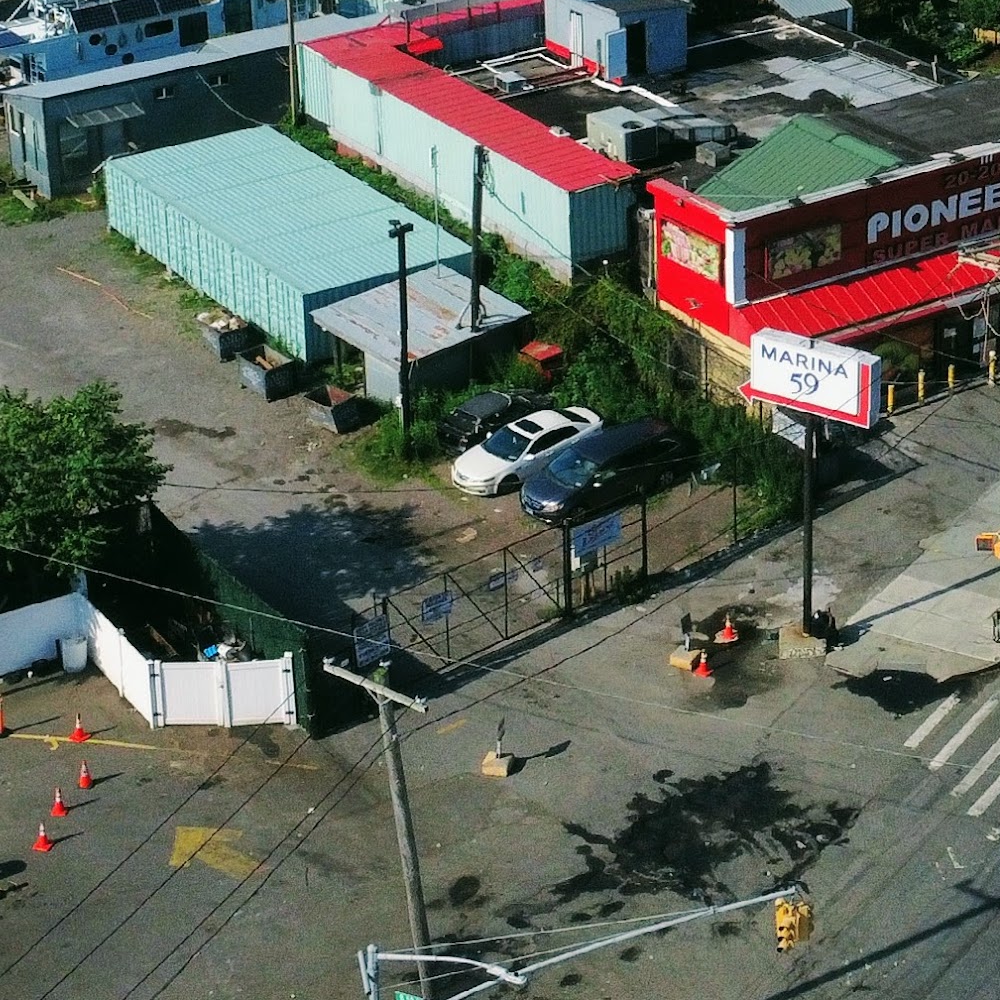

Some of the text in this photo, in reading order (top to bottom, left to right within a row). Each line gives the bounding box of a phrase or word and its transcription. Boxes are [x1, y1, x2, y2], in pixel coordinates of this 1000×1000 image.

[944, 163, 1000, 189] 20-20
[872, 231, 950, 264] SUPER
[761, 343, 848, 379] MARINA
[790, 372, 819, 396] 59
